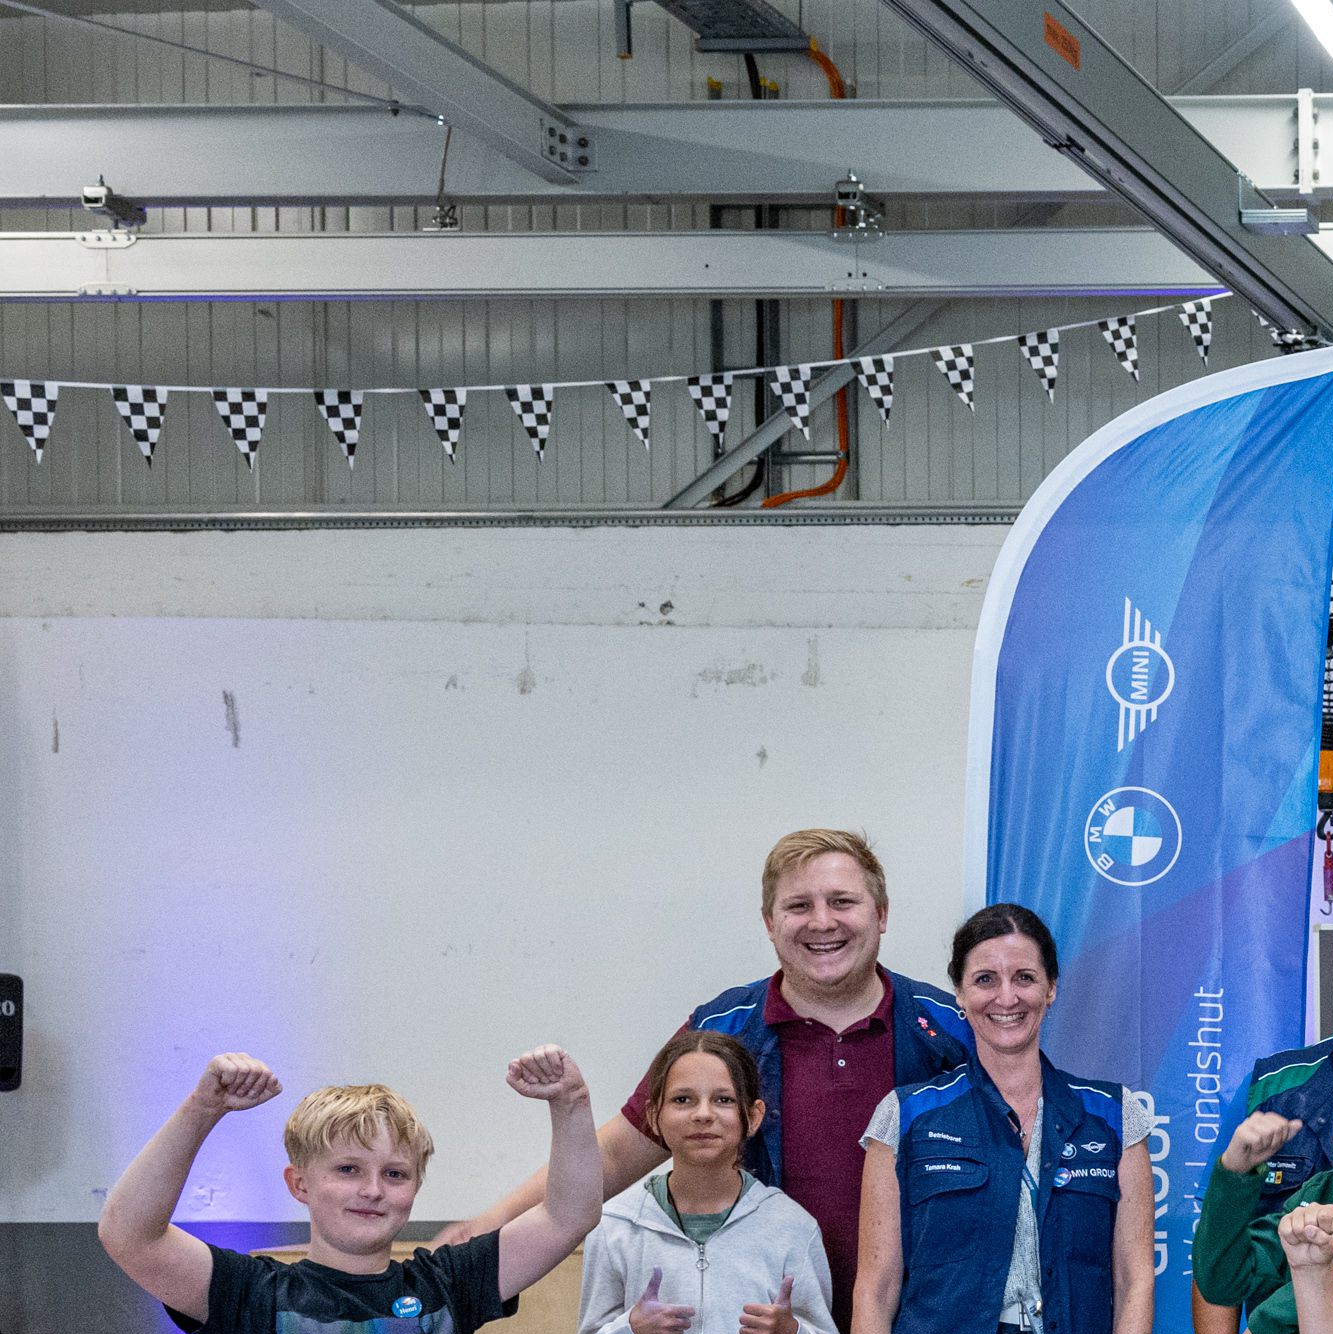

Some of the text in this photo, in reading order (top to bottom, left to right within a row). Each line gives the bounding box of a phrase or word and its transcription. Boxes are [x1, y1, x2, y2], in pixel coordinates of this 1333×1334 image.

[1131, 651, 1150, 701] MINI
[1071, 1168, 1116, 1178] MW GROUP
